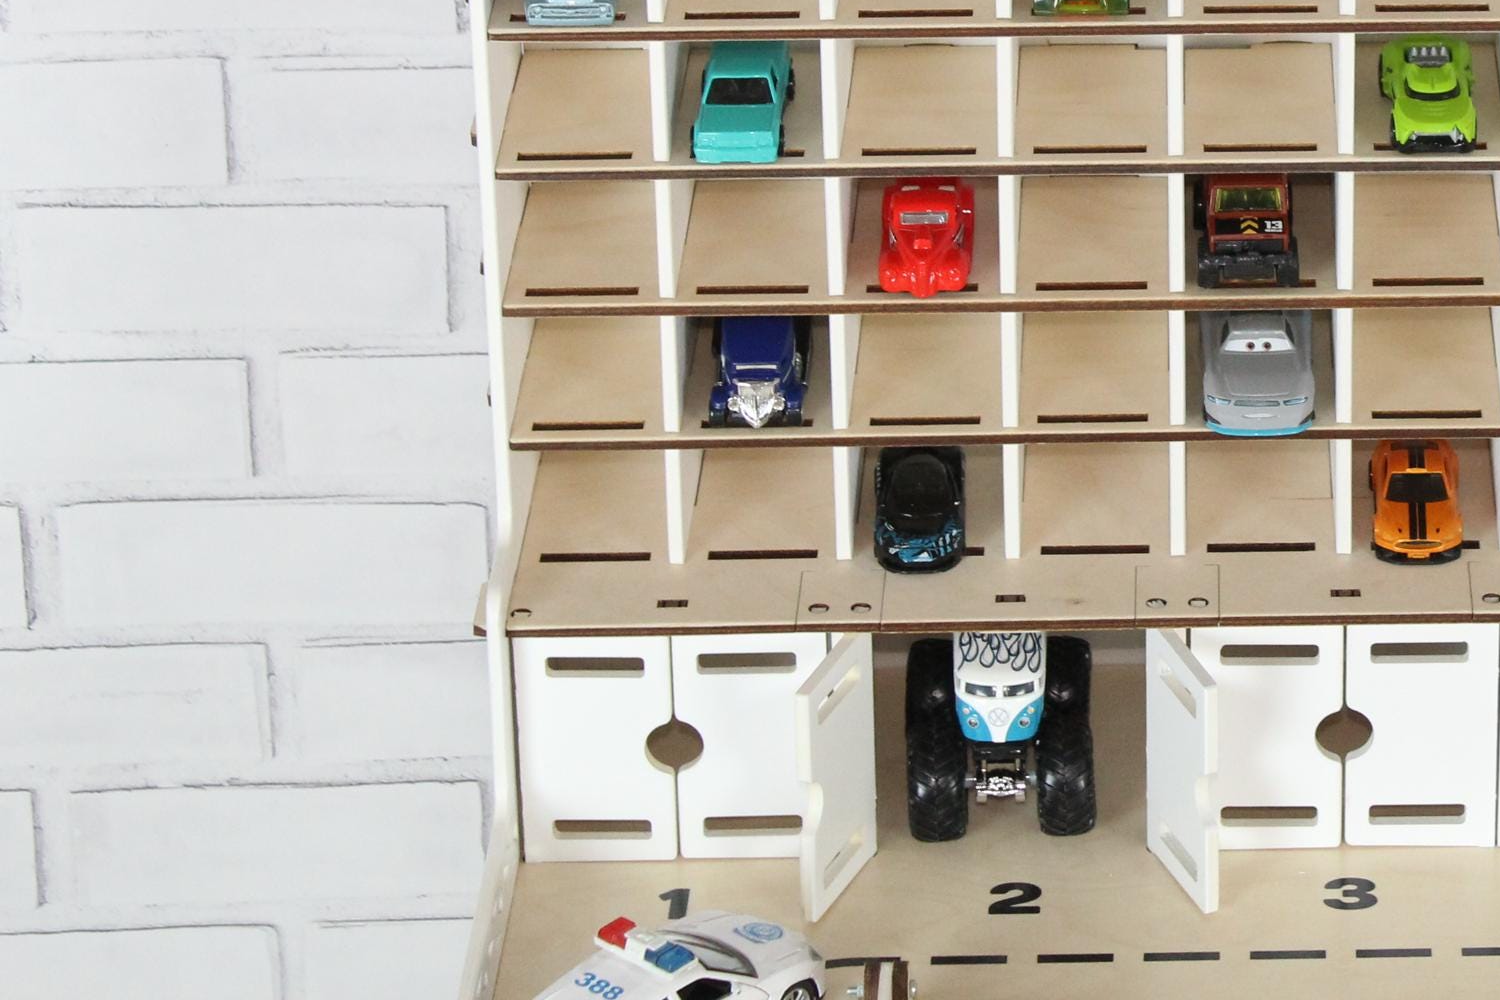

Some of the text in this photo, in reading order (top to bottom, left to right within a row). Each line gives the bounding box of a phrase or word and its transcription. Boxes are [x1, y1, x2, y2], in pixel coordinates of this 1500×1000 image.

[1263, 220, 1284, 230] 13
[658, 887, 691, 919] 1
[988, 881, 1042, 915] 2
[1323, 877, 1378, 910] 3
[574, 972, 624, 1000] 388
